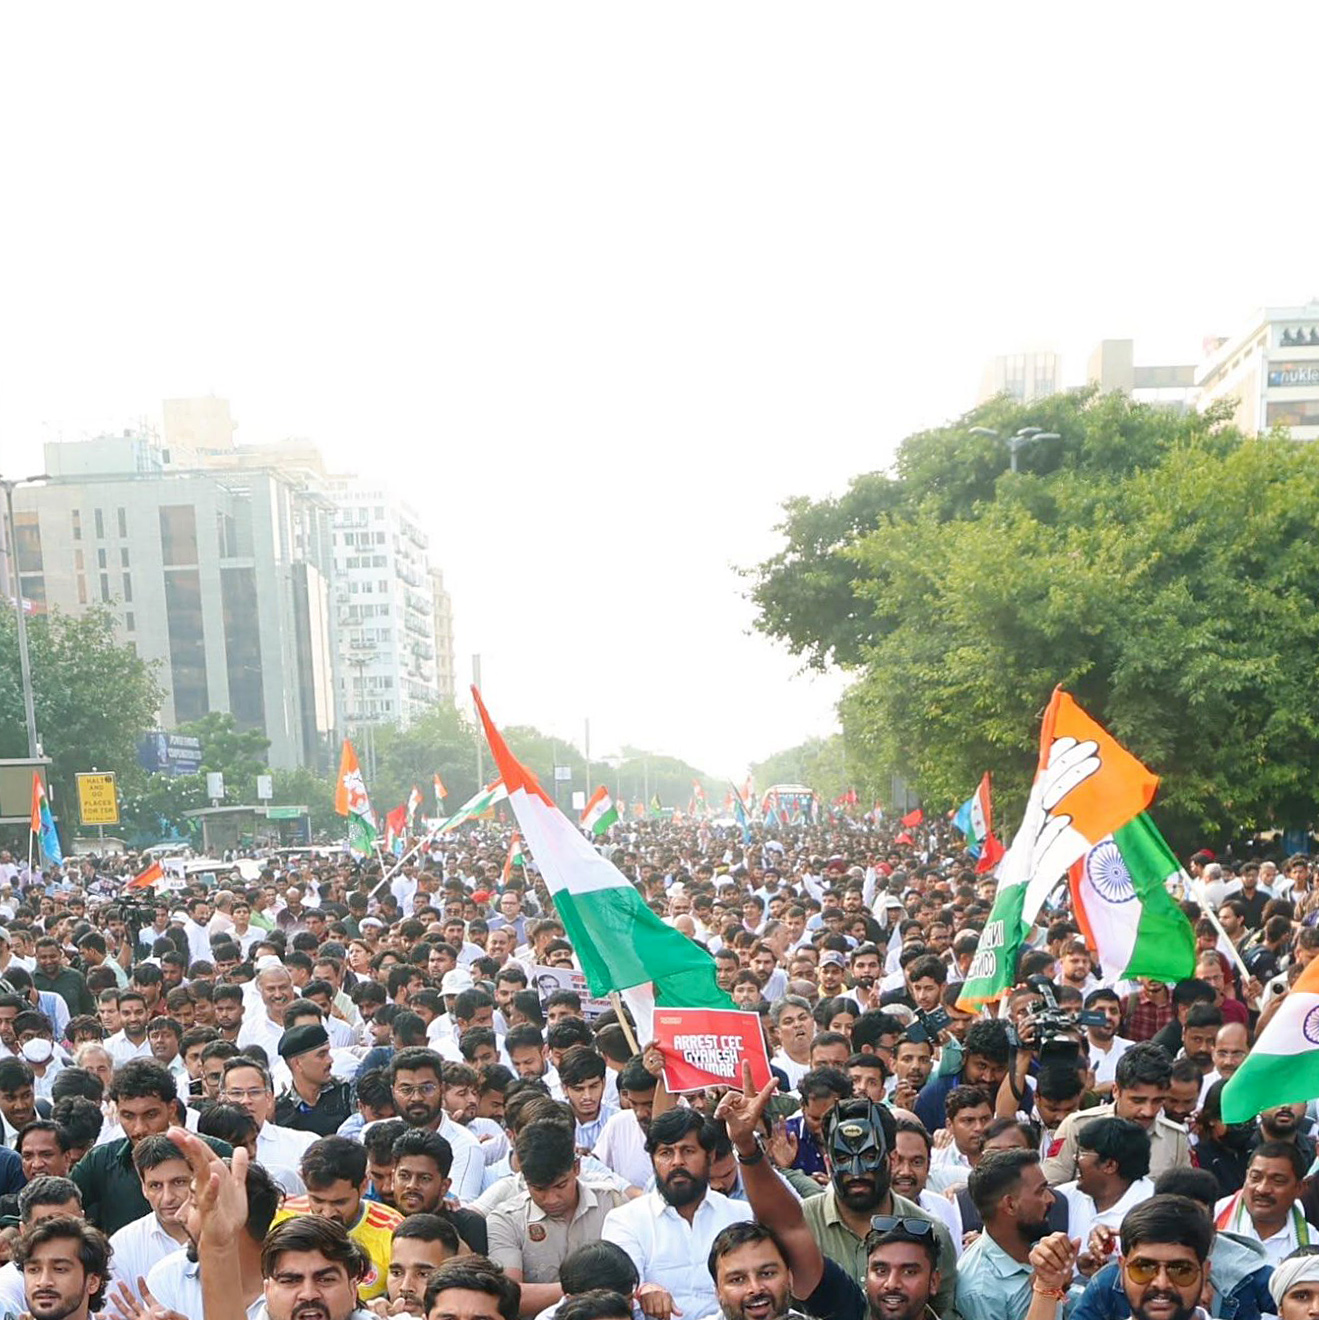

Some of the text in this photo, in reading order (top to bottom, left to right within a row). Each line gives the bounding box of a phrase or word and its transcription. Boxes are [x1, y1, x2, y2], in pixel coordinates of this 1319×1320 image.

[673, 1034, 745, 1051] ARREST CEC
[683, 1048, 740, 1065] GYANESH
